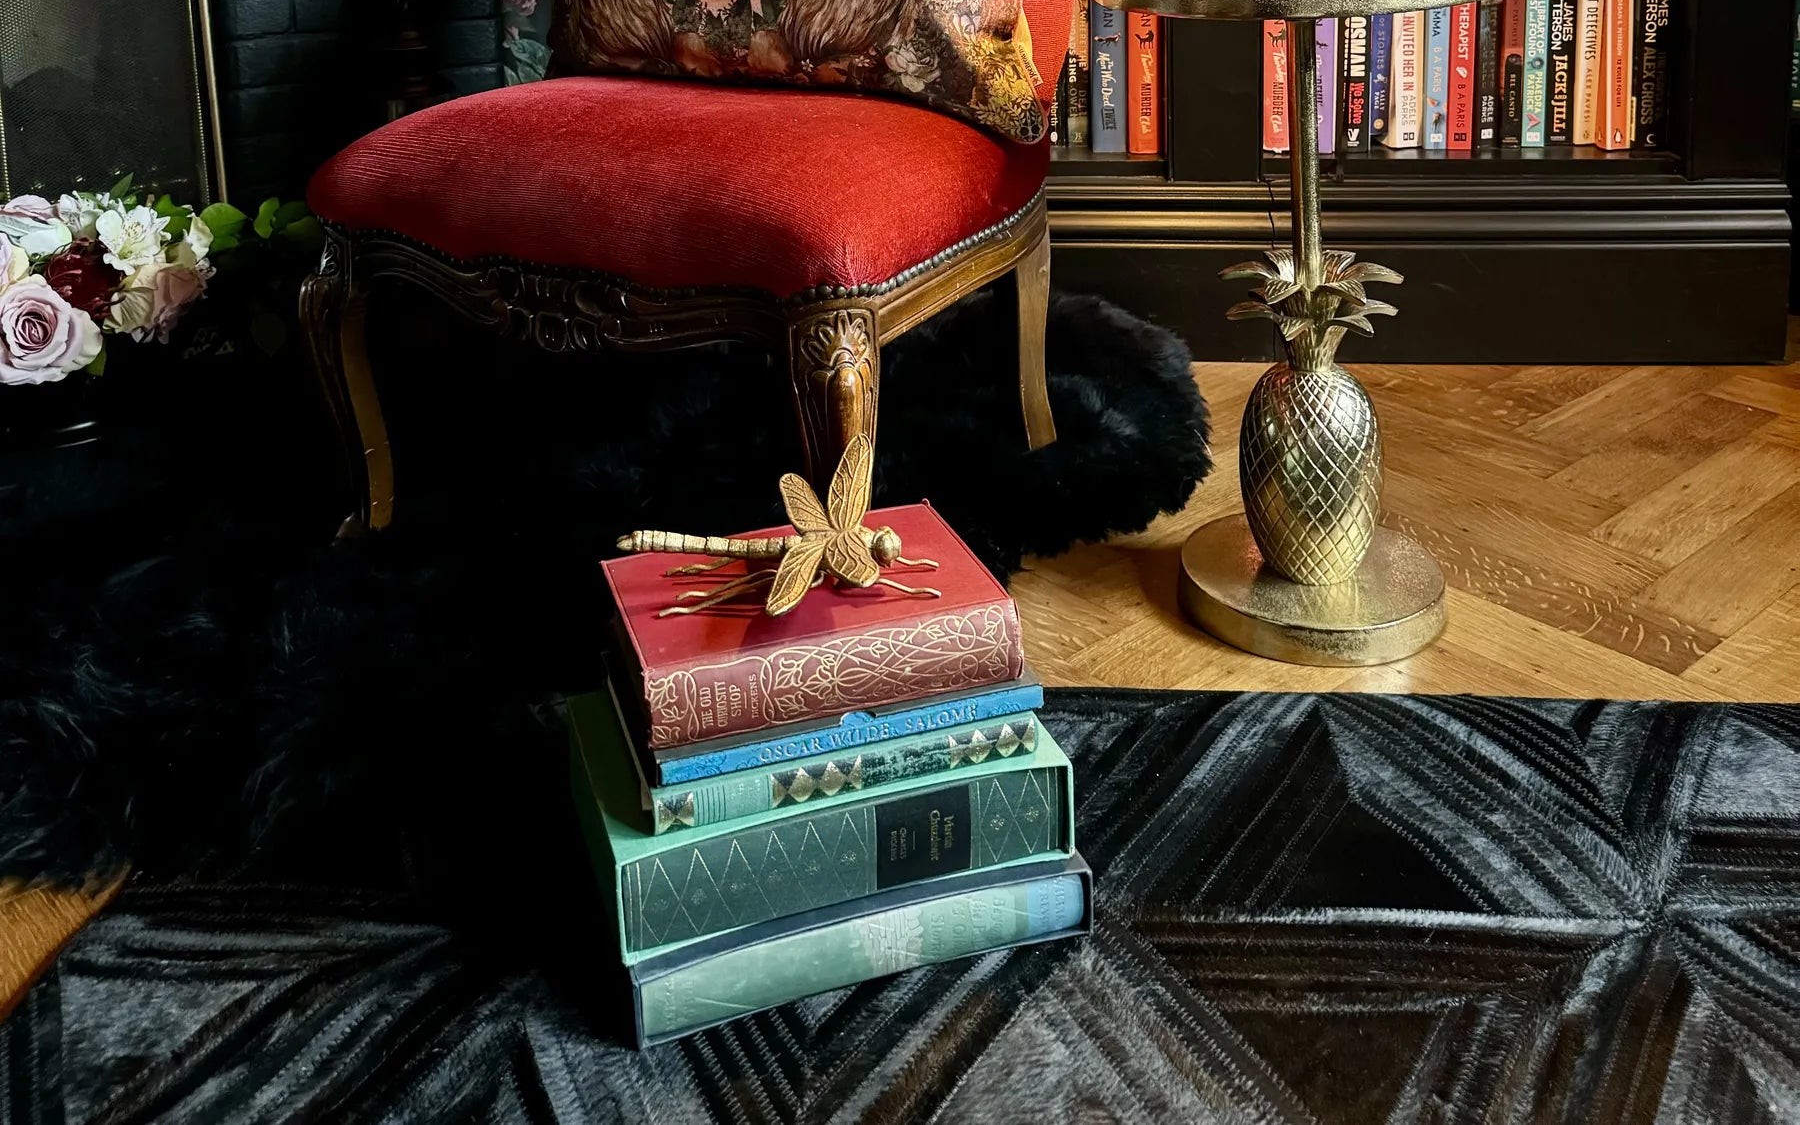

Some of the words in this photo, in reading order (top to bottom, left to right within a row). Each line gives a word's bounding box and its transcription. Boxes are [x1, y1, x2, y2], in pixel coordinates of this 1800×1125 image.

[1563, 2, 1574, 42] JAMES
[1585, 7, 1598, 60] DETECTIVES
[1097, 52, 1109, 69] Man
[1344, 17, 1367, 76] OSMAN
[1069, 58, 1077, 83] SING
[1101, 69, 1116, 87] Who
[1643, 47, 1654, 79] ALEX
[1101, 88, 1114, 107] Died
[1354, 82, 1364, 97] We
[1526, 74, 1535, 111] PATRICK
[1534, 71, 1543, 114] PHAEDRA
[1640, 83, 1654, 125] CROSS
[1050, 101, 1059, 127] North
[1101, 108, 1117, 131] TWICE
[1353, 98, 1365, 124] Solve
[1401, 95, 1409, 126] PARKS
[1457, 103, 1466, 128] PARIS
[700, 687, 712, 707] OLD
[714, 681, 728, 727] CURIOSITY
[729, 685, 742, 717] SHOP
[749, 674, 759, 718] DICKENS
[702, 711, 714, 729] THE
[759, 739, 823, 763] OSCAR
[831, 723, 890, 747] WILDE
